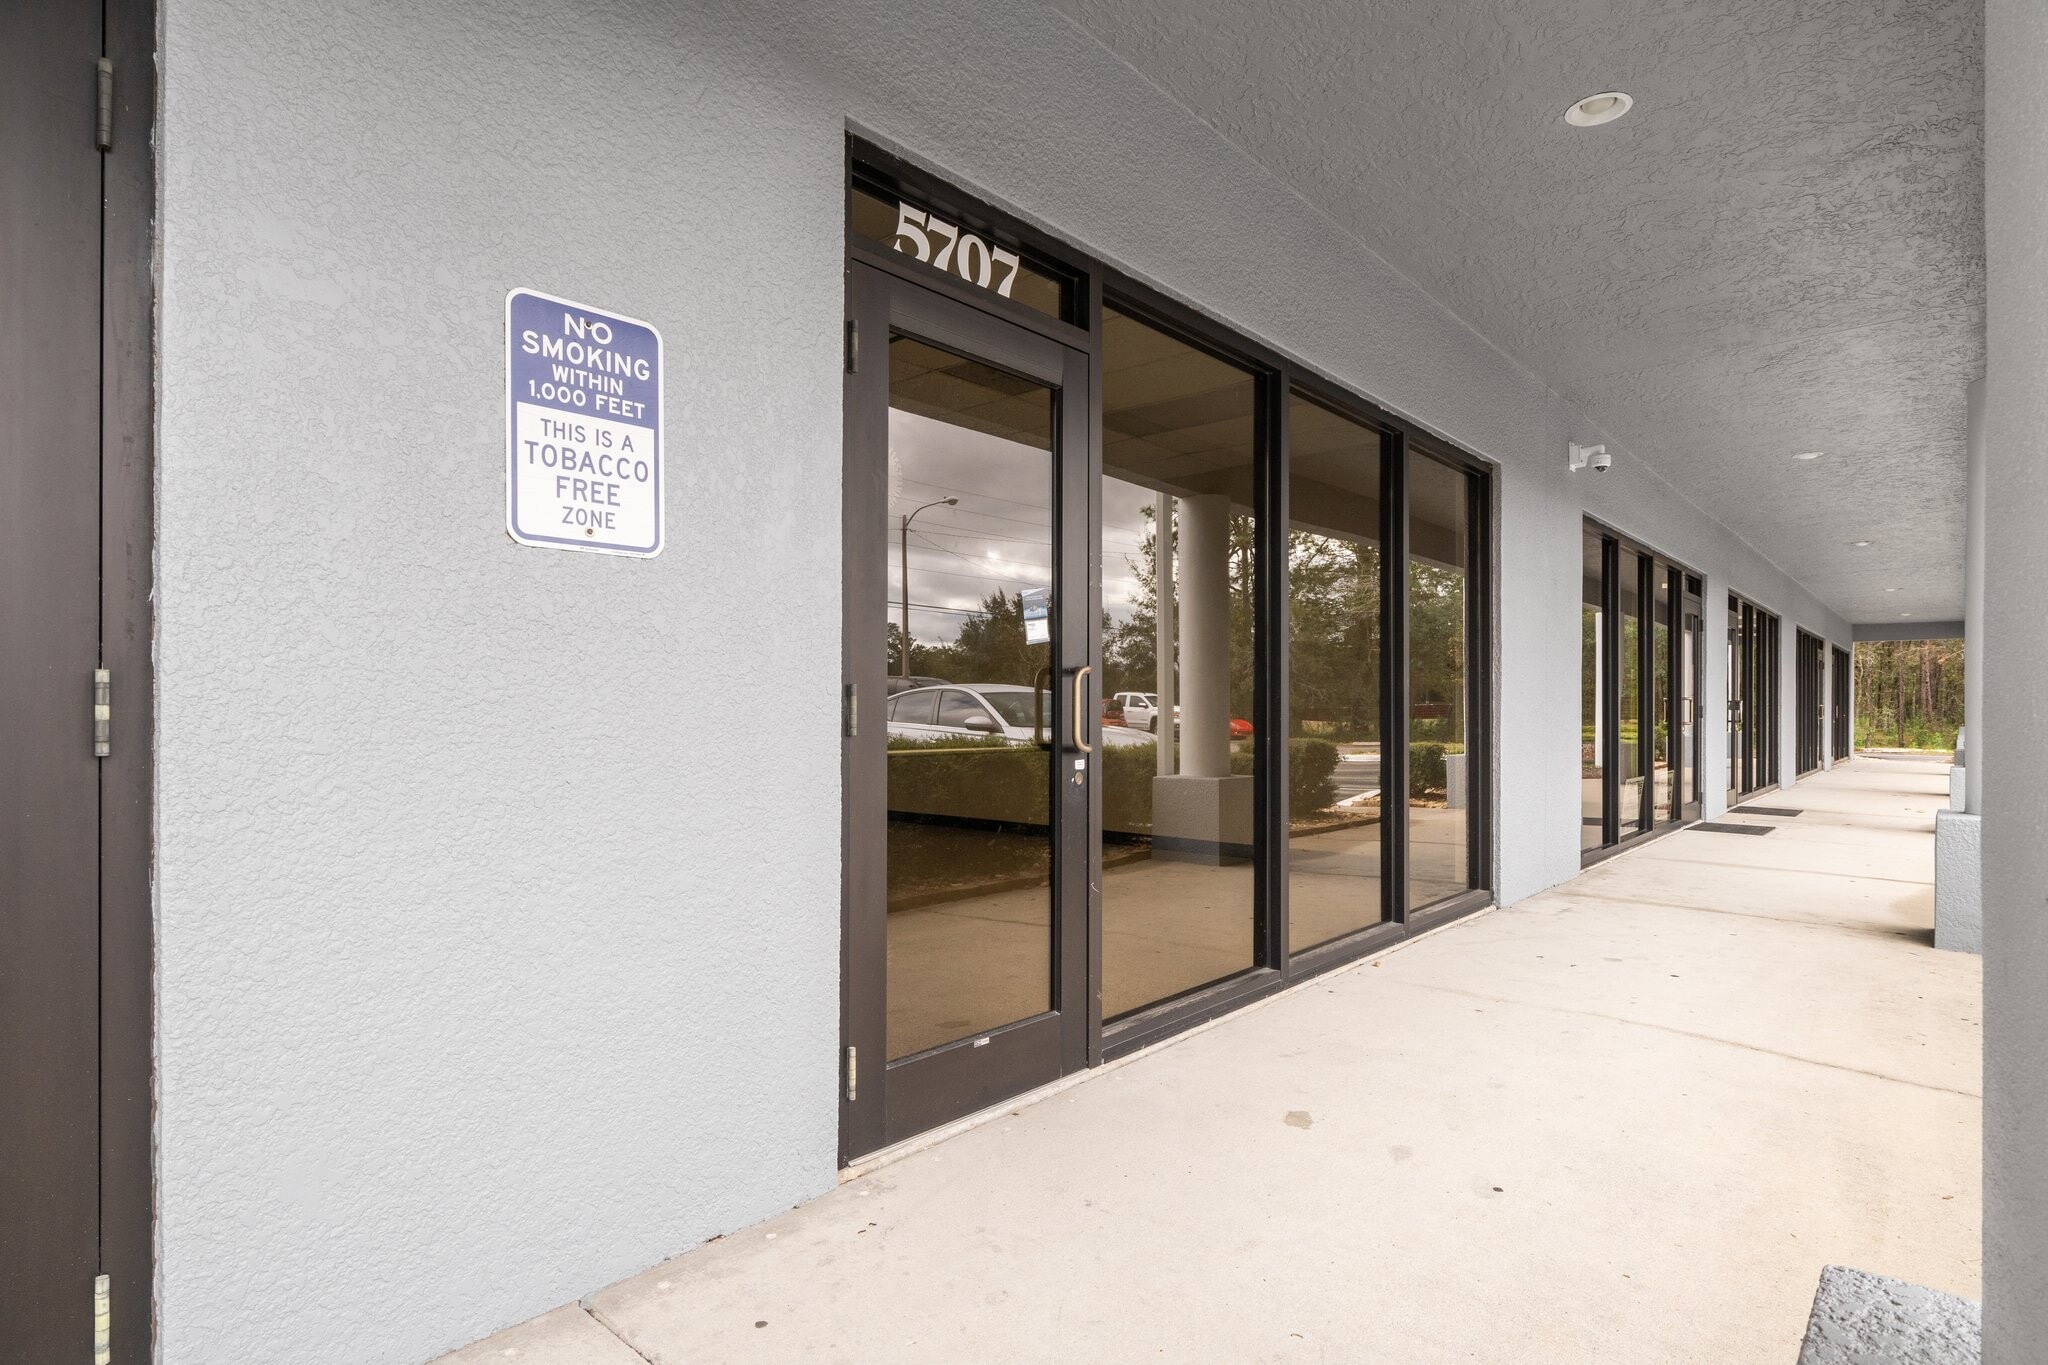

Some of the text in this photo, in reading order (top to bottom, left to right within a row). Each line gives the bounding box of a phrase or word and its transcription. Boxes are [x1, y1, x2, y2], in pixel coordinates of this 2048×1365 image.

[894, 201, 1019, 298] 5707
[564, 313, 613, 344] NO
[522, 330, 650, 380] SMOKING
[552, 364, 623, 396] WITHIN
[529, 380, 645, 419] 1,000 FEET
[541, 418, 634, 452] THIS IS A
[524, 440, 648, 482] TOBACCO
[557, 476, 620, 506] FREE
[562, 506, 616, 529] ZONE
